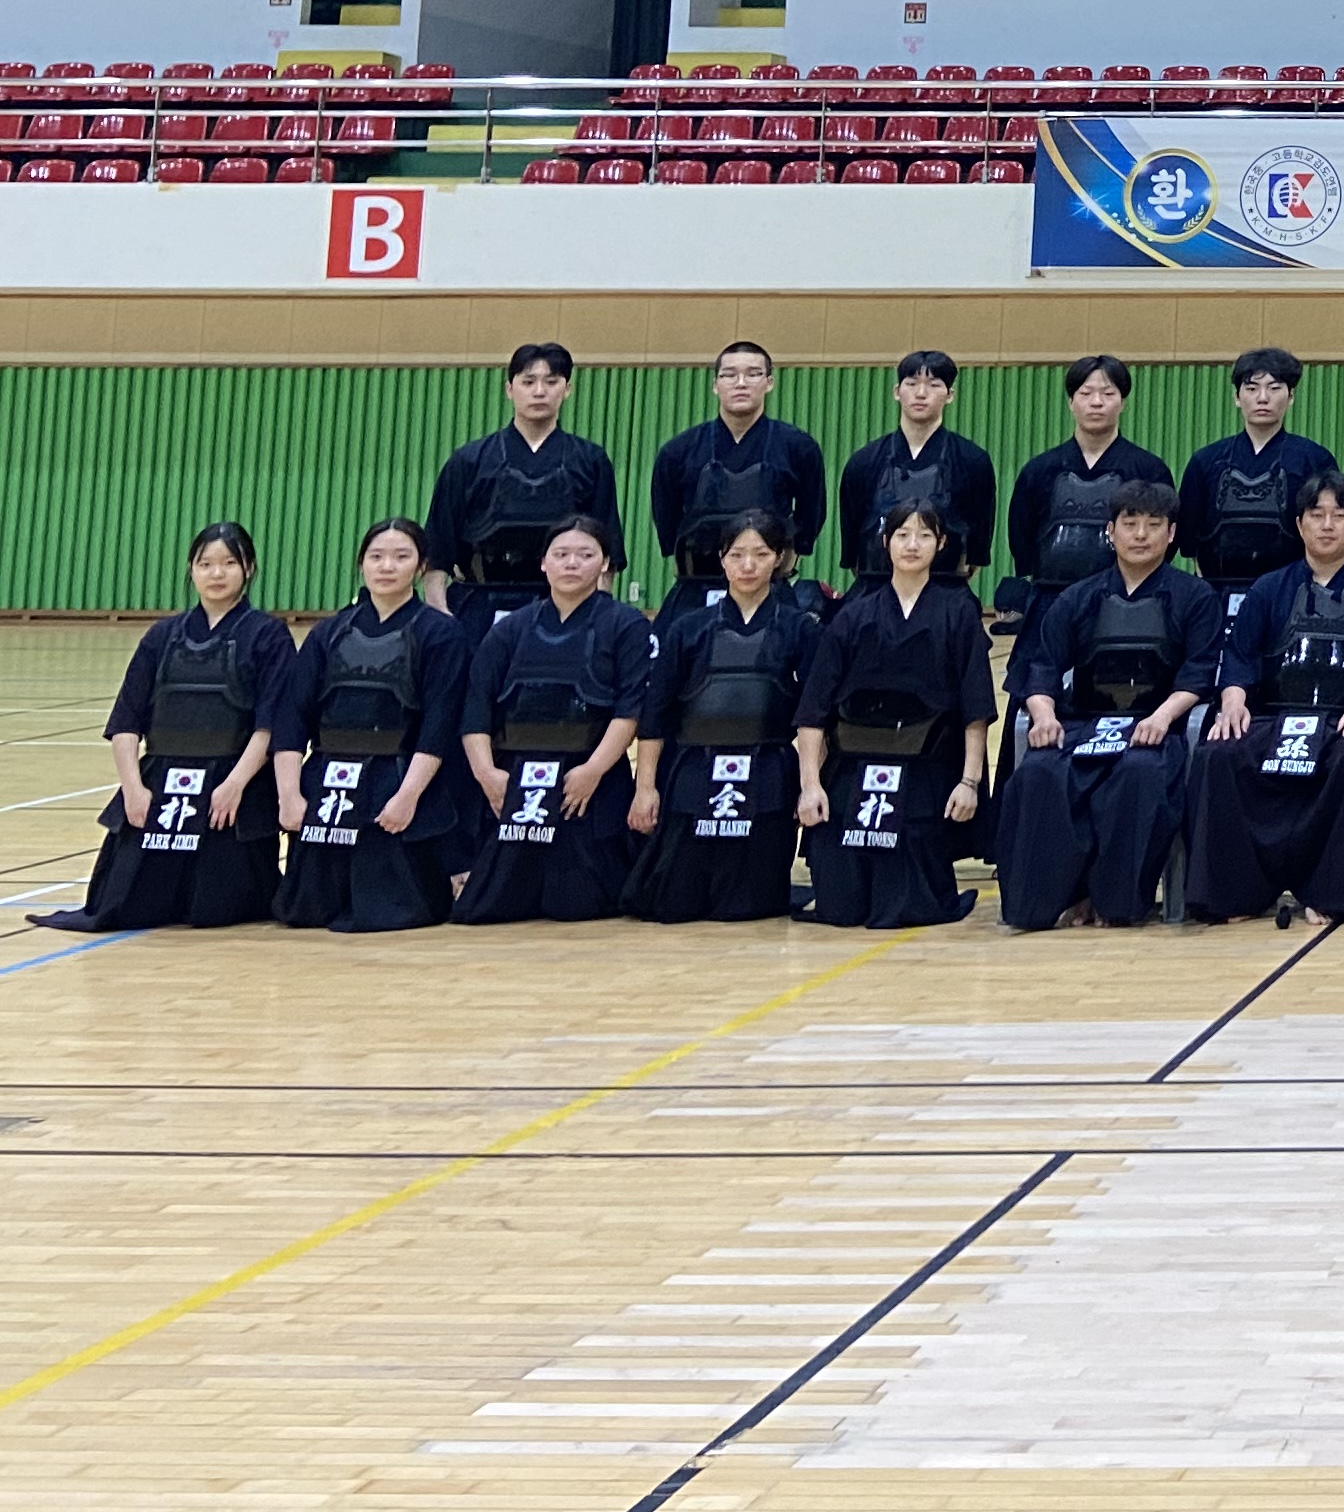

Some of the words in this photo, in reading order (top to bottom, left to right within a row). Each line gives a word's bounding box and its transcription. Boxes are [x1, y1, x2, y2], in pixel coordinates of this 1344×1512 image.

[1148, 168, 1193, 219] 환
[350, 195, 405, 274] B
[158, 796, 197, 831] 朴
[318, 790, 354, 825] 朴
[858, 793, 894, 828] 朴
[142, 833, 170, 849] PARK
[301, 826, 327, 842] PARK
[499, 825, 526, 840] KANG
